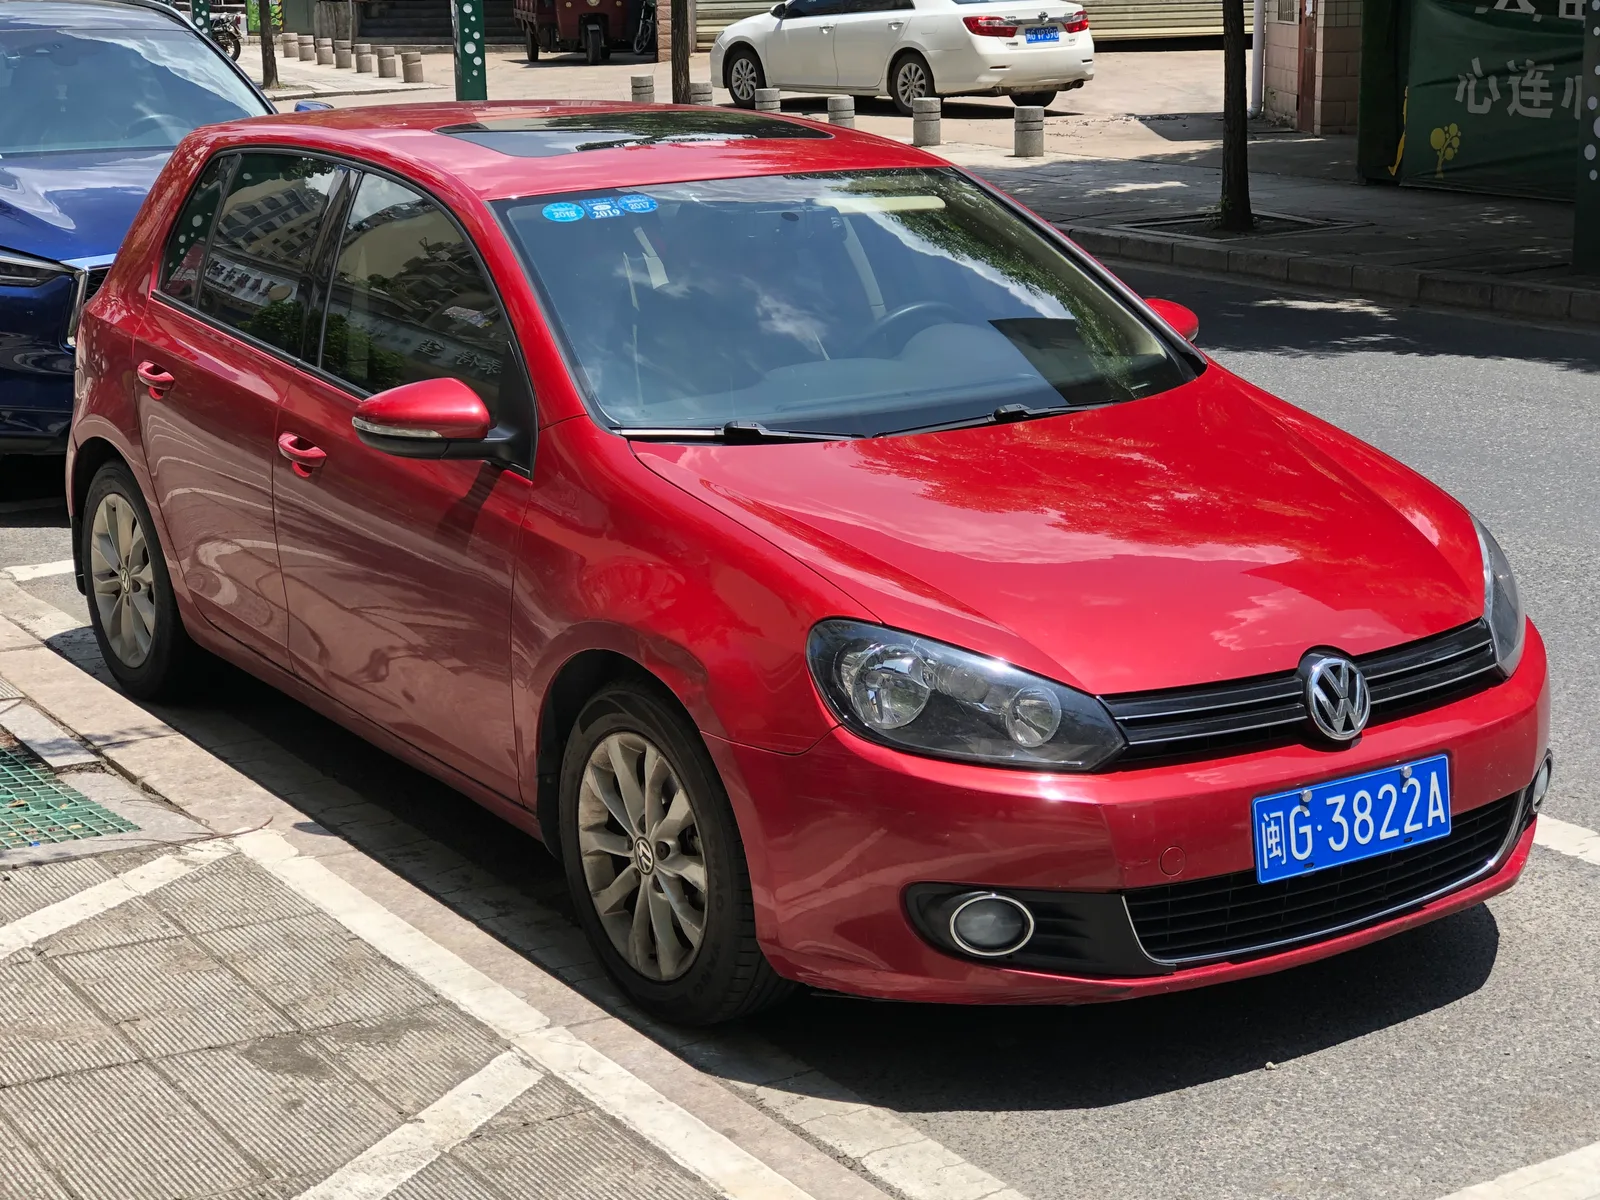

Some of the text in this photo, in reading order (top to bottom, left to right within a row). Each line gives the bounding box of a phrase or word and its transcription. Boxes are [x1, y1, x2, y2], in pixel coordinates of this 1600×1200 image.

[628, 201, 651, 211] 2017
[553, 210, 577, 220] 2018
[592, 208, 621, 220] 2019
